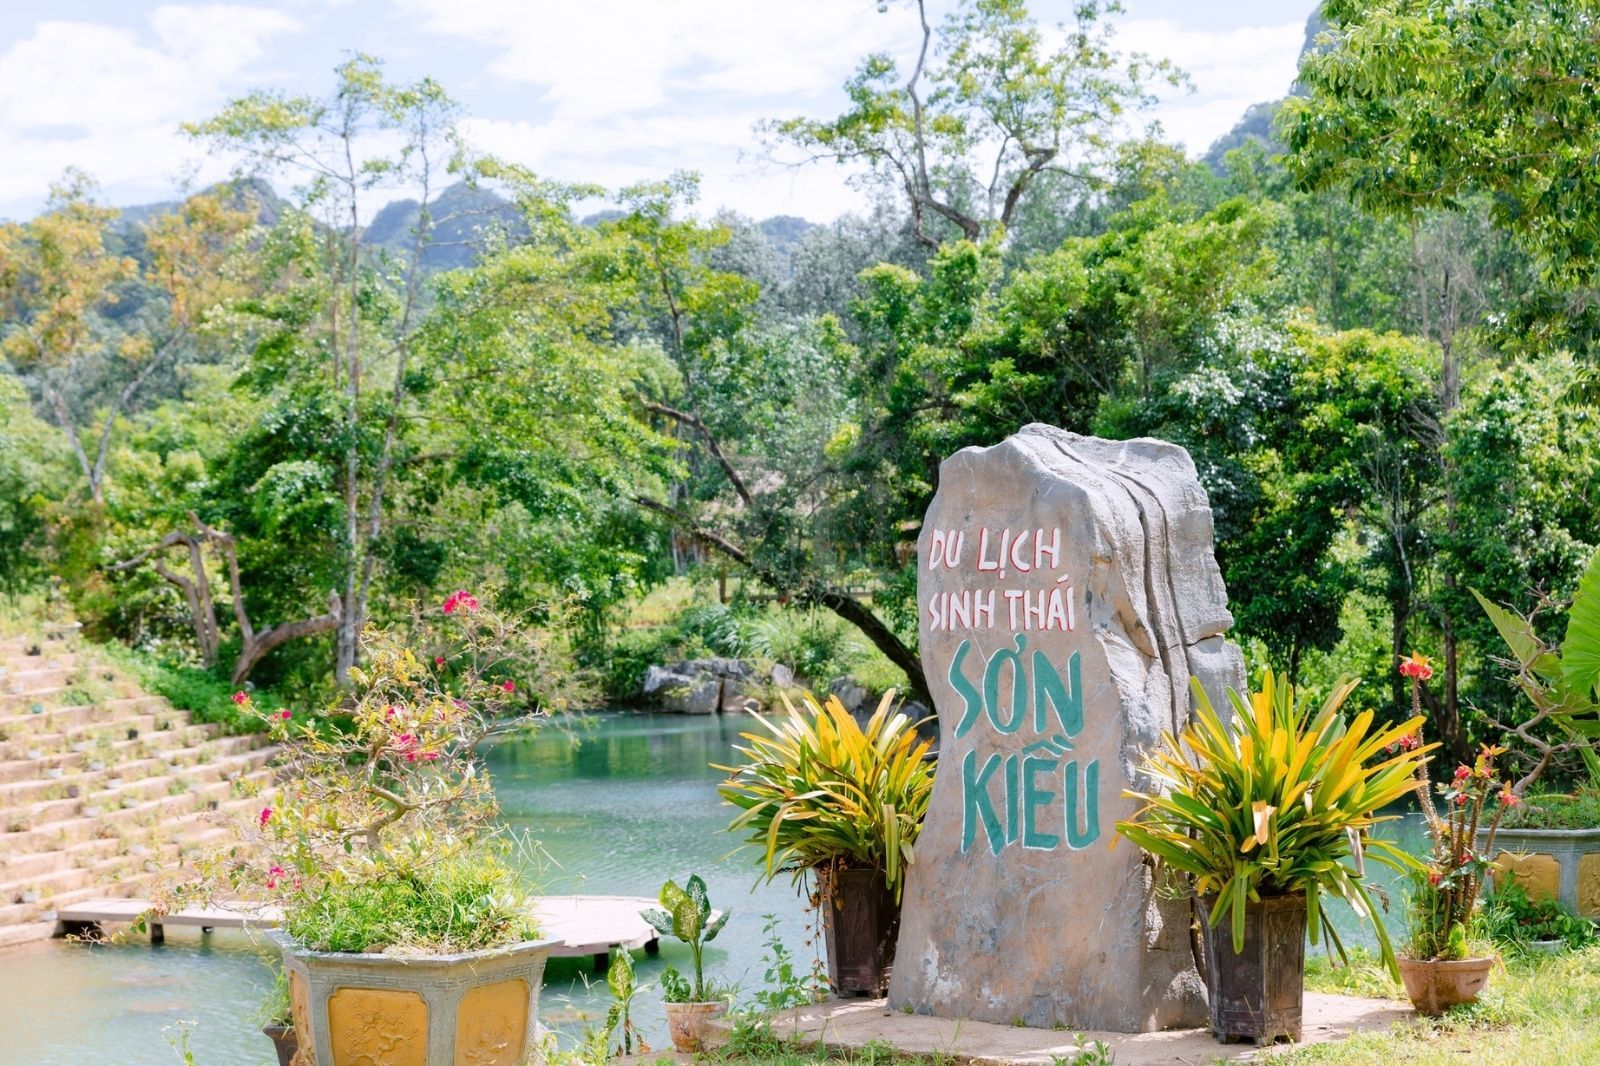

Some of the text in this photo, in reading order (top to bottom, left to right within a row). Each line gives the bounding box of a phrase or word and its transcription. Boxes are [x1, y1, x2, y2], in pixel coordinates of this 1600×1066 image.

[928, 527, 1061, 579] DU LỊCH
[928, 574, 1075, 632] SINH THÁI
[948, 633, 1084, 739] SƠN
[961, 734, 1101, 857] KIỀU
